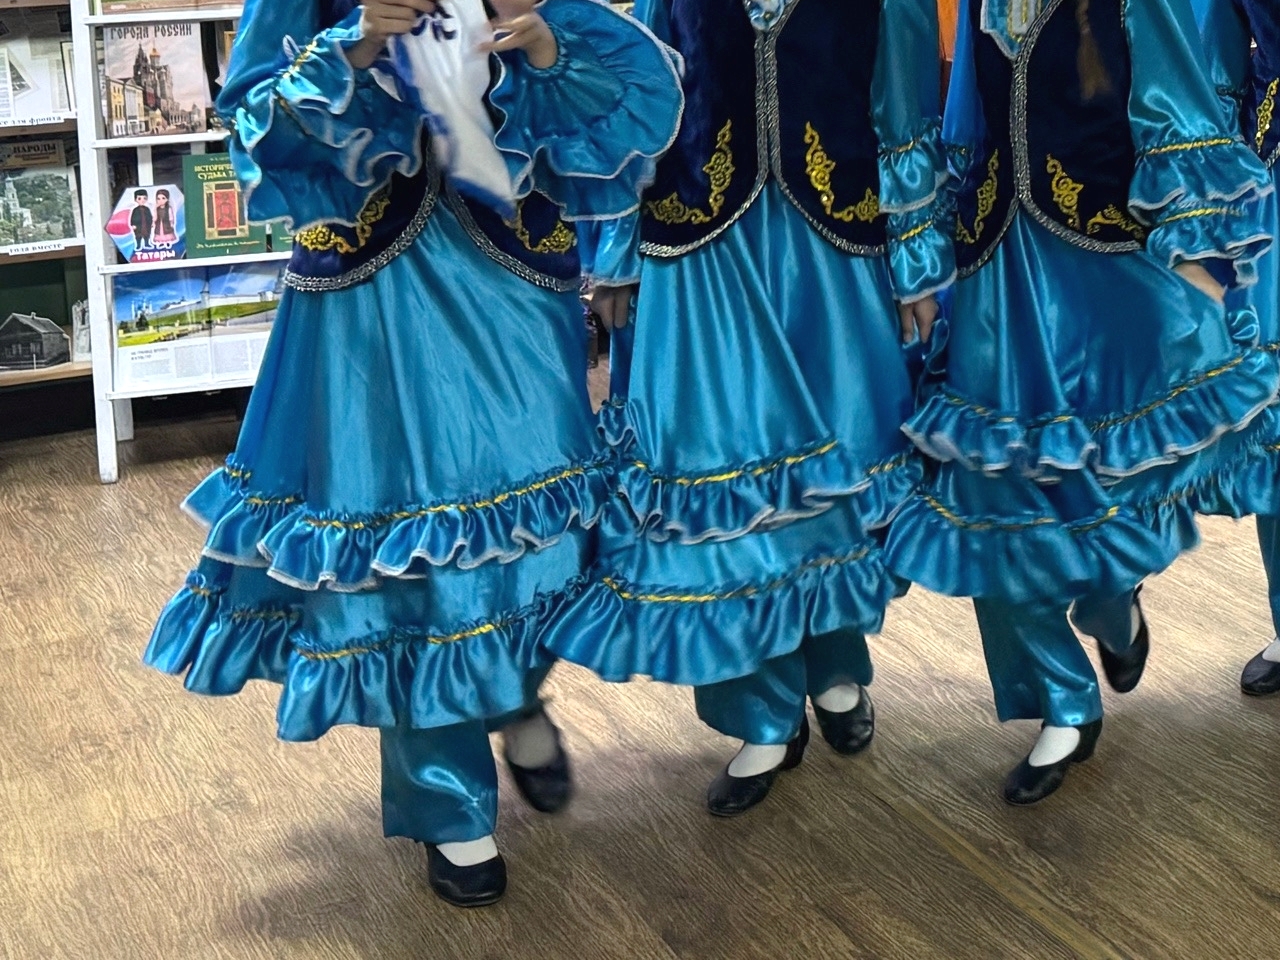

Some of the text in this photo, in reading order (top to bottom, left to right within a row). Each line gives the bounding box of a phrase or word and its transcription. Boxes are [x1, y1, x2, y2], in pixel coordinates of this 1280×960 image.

[110, 23, 192, 40] ГОРОДА РОССИИ
[13, 143, 57, 154] НАРОДЫ
[135, 249, 176, 261] Татары
